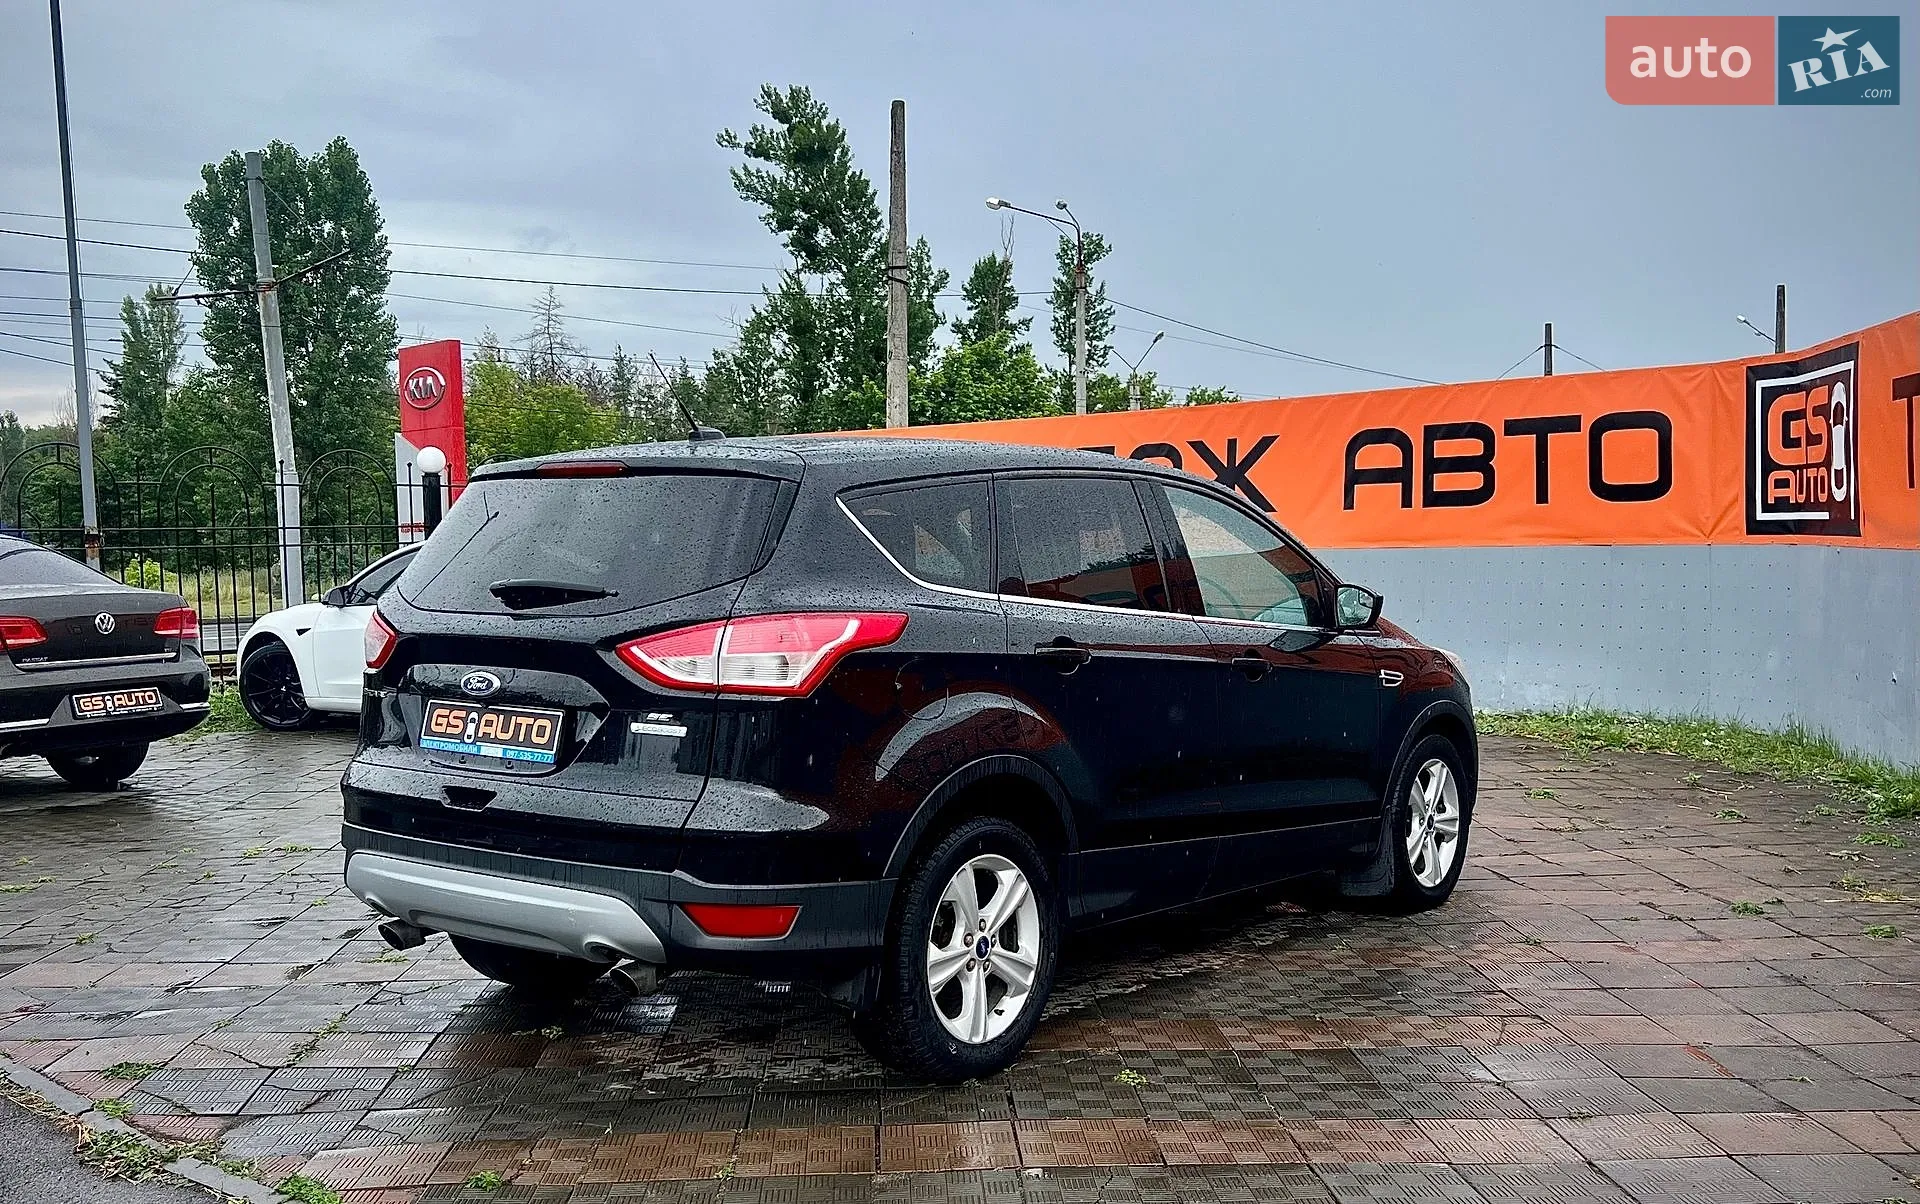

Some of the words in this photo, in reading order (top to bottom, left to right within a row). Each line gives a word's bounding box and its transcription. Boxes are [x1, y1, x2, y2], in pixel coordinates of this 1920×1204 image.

[408, 375, 438, 400] KIA
[1767, 384, 1829, 466] GS
[1343, 410, 1673, 511] АВТО
[1767, 466, 1829, 504] AUTO
[80, 696, 105, 711] GS
[113, 691, 156, 707] AUTO
[430, 708, 467, 735] GS
[478, 713, 552, 744] AUTO
